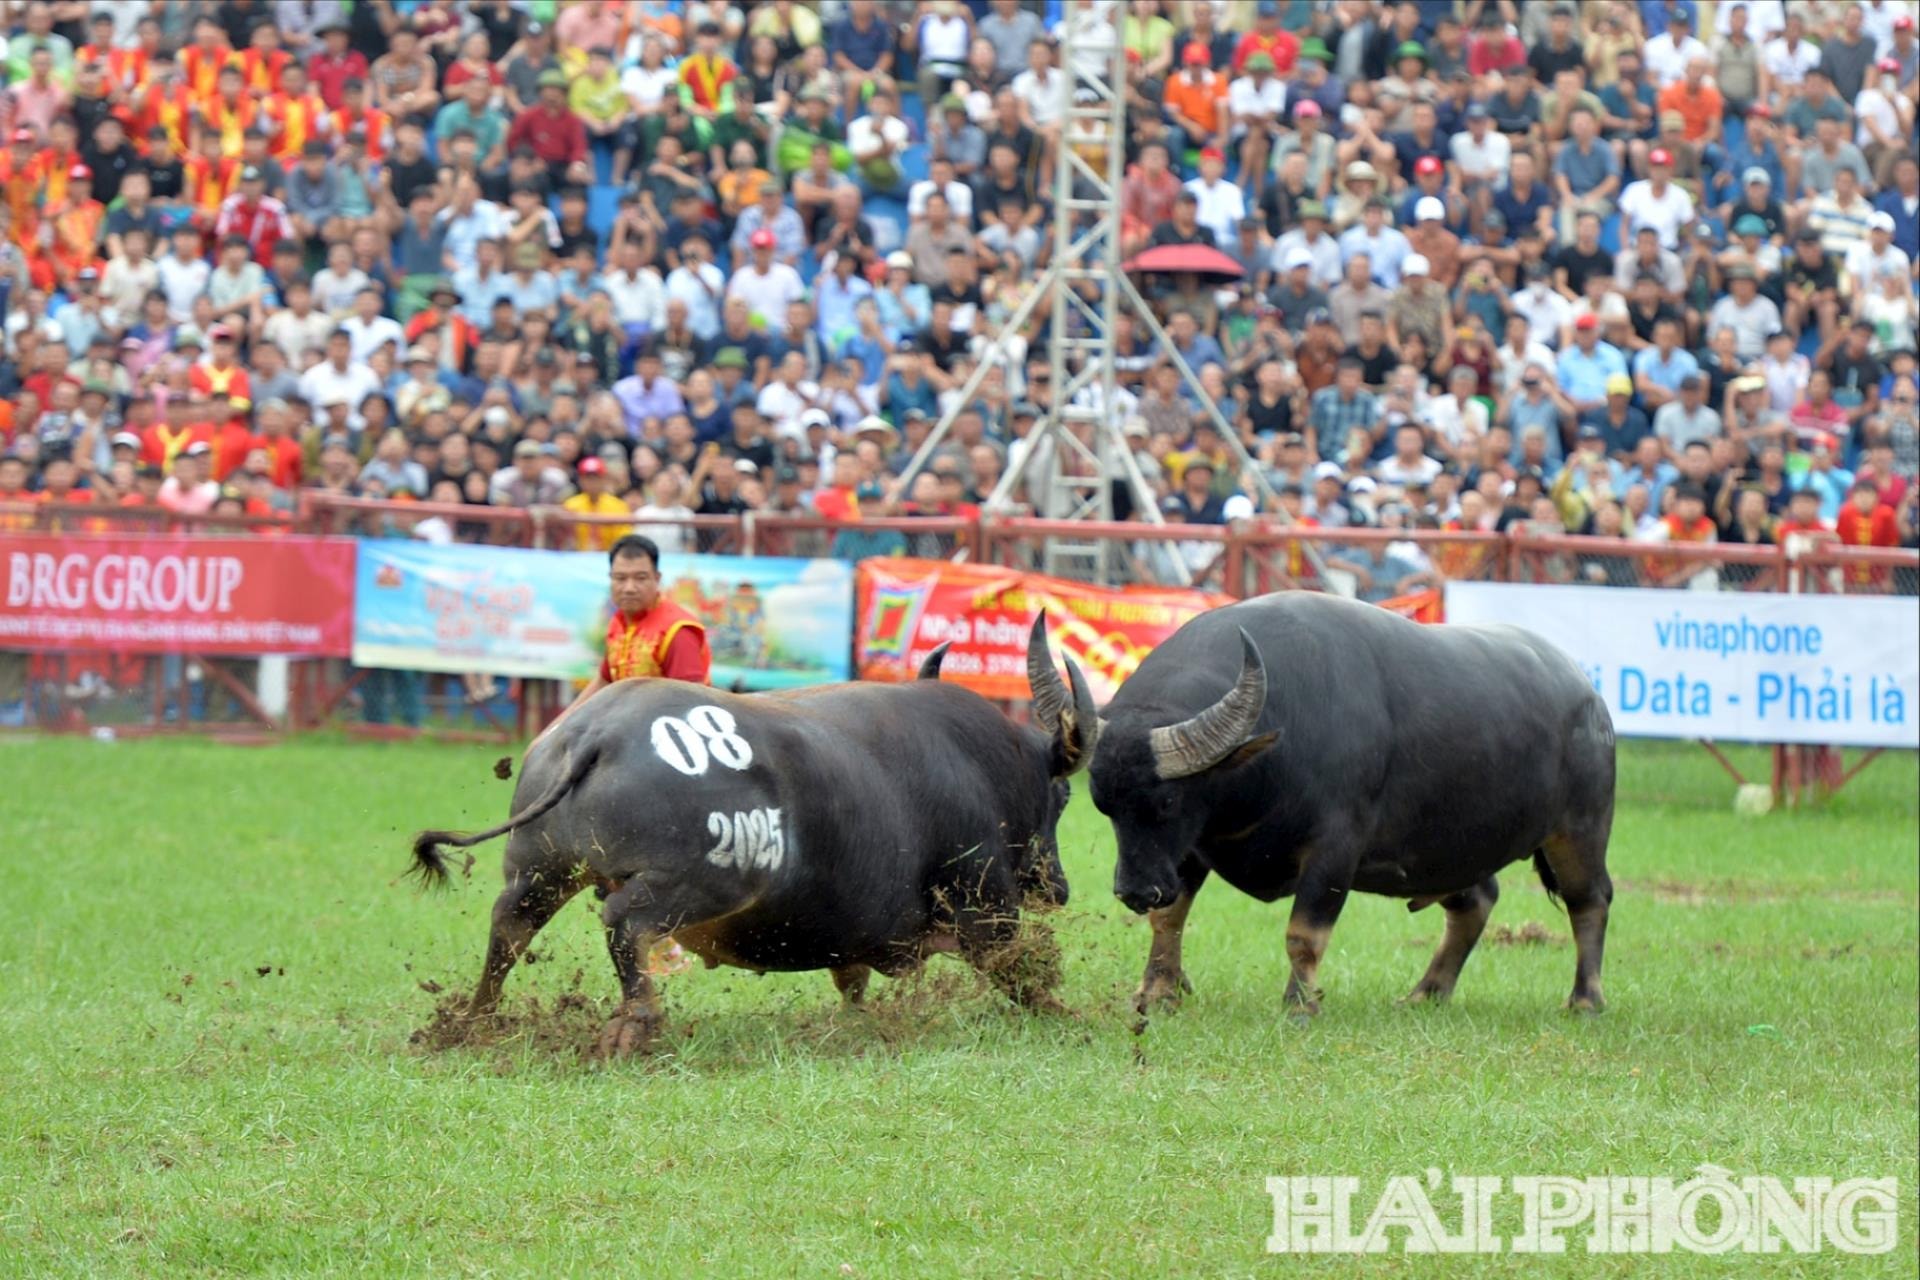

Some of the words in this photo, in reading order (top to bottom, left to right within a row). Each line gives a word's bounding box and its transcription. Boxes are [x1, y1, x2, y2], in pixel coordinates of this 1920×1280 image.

[8, 552, 90, 609] BRG
[93, 554, 244, 612] GROUP
[1654, 611, 1822, 658] vinaphone
[1619, 666, 1712, 716] Data
[1757, 666, 1852, 722] Phải
[1871, 672, 1906, 724] là
[651, 705, 753, 775] 08
[705, 806, 784, 874] 2025
